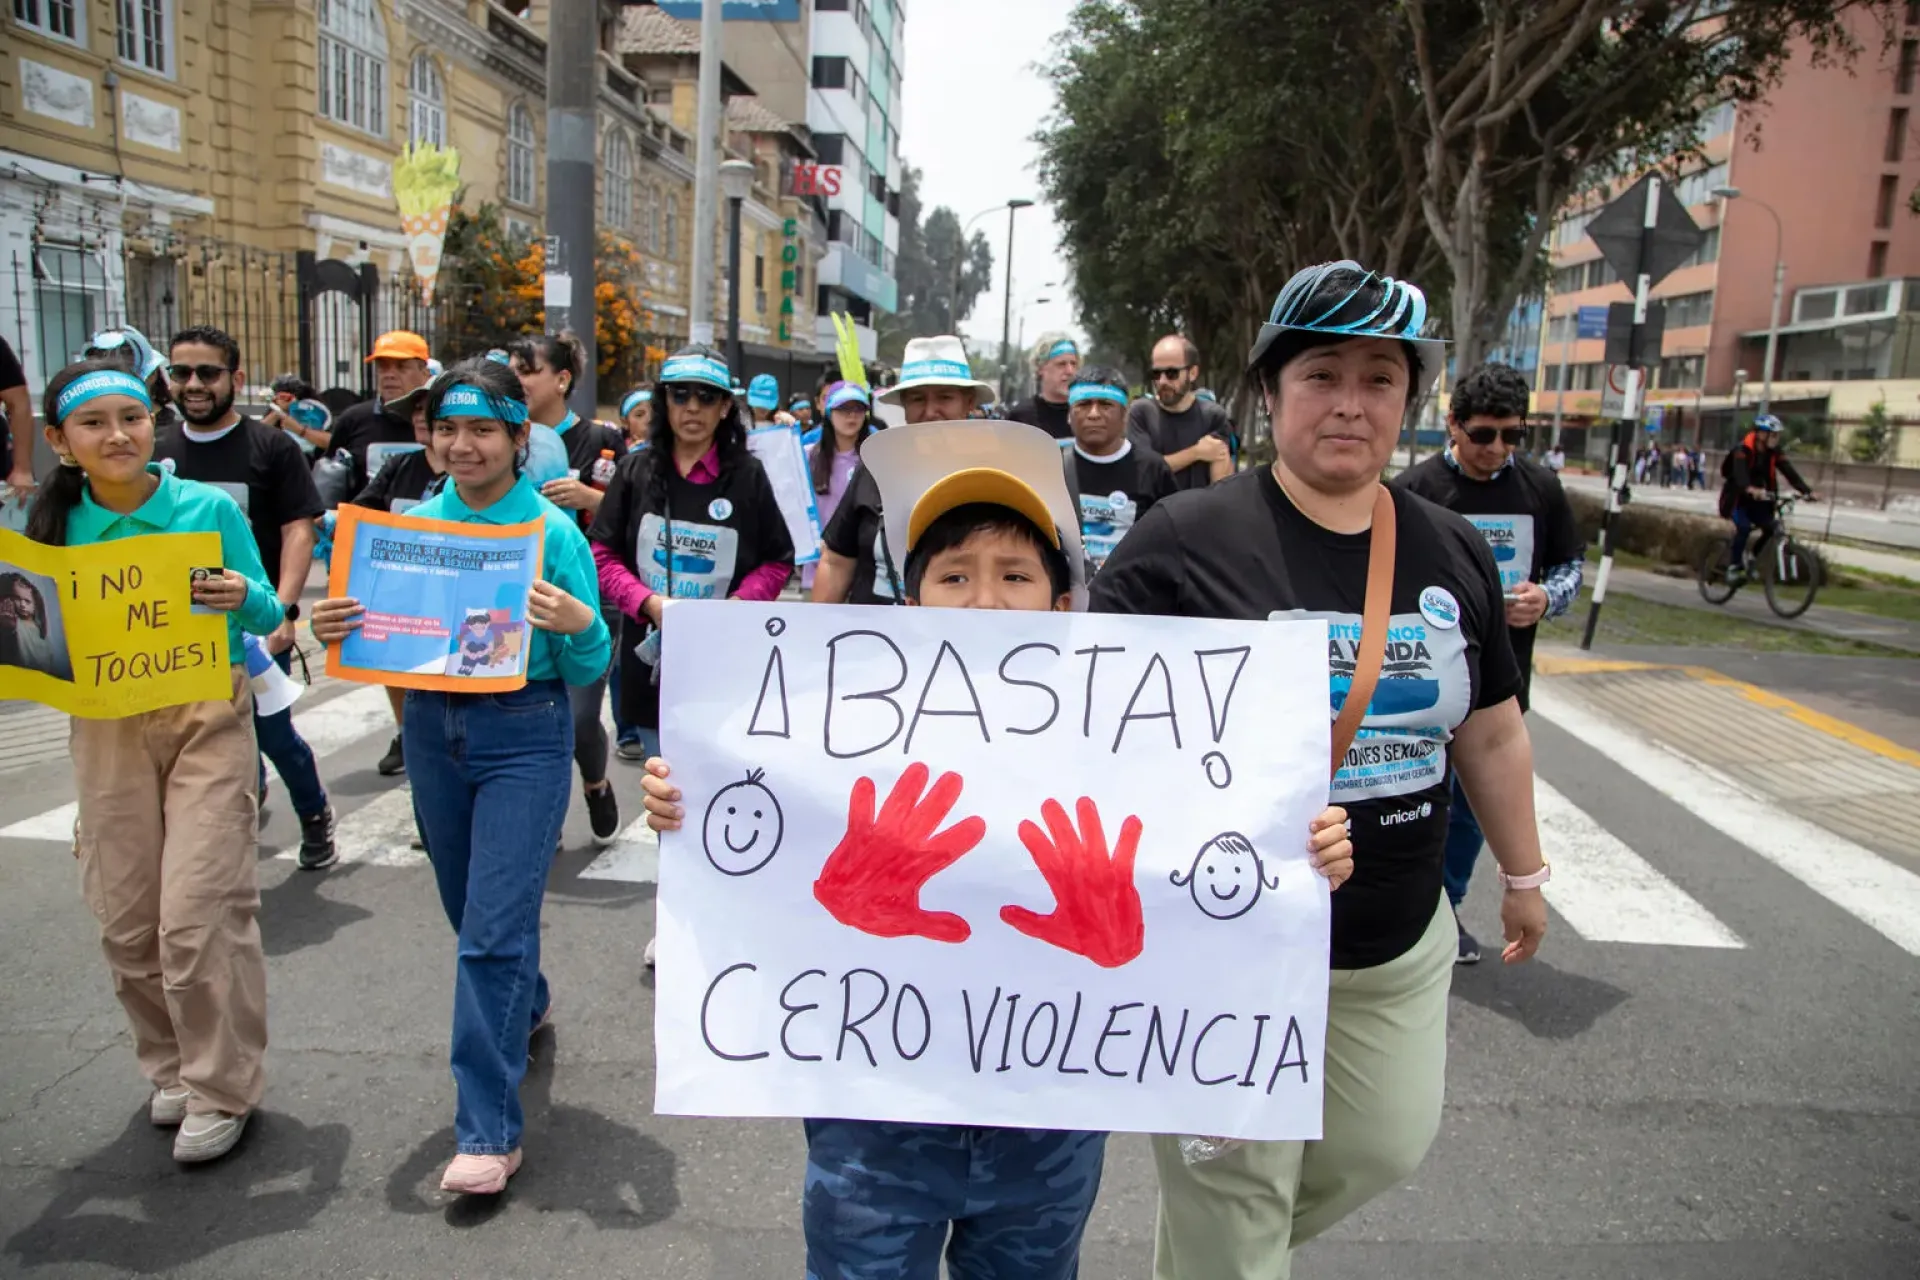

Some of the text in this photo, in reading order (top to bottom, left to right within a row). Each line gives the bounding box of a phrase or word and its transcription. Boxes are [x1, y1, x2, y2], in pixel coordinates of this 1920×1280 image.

[779, 218, 797, 342] CORAL
[373, 539, 401, 553] CADA
[439, 548, 484, 561] REPORTA
[675, 535, 717, 551] VENDA
[372, 549, 386, 560] DE
[388, 551, 441, 566] VIOLENCIA
[444, 557, 481, 570] SEXUAL
[101, 564, 143, 600] NO
[126, 600, 169, 632] ME
[1329, 640, 1432, 661] A VNDA
[86, 641, 217, 687] TOQUES!
[748, 615, 1251, 789] ¡BASTA!
[1340, 744, 1381, 767] IONES
[1334, 777, 1363, 790] HOMBRE
[1380, 805, 1421, 826] unicef
[701, 963, 1309, 1095] CERO VIOLENCIA
